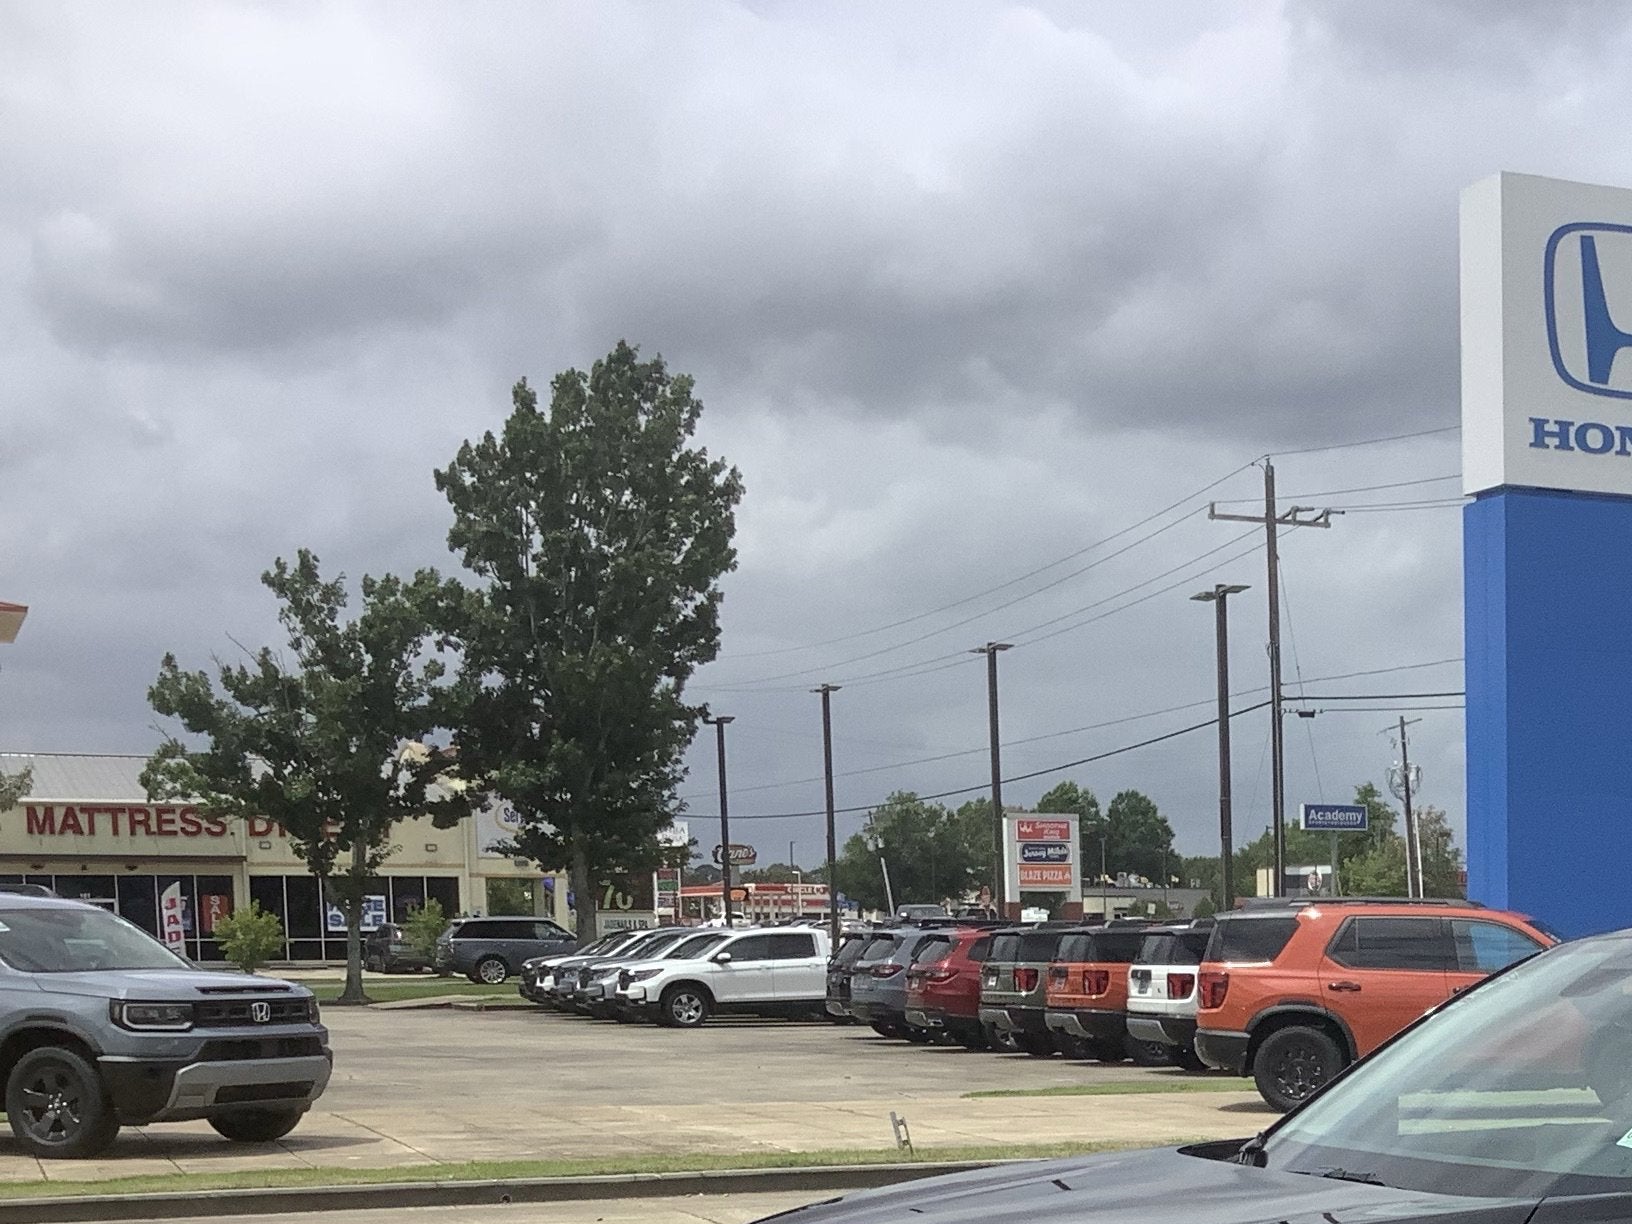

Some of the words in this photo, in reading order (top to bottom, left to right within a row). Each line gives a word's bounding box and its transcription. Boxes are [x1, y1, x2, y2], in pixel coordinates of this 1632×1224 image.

[26, 806, 228, 838] MATTRESS
[1308, 809, 1363, 825] Academy
[1043, 870, 1063, 881] PIZZA
